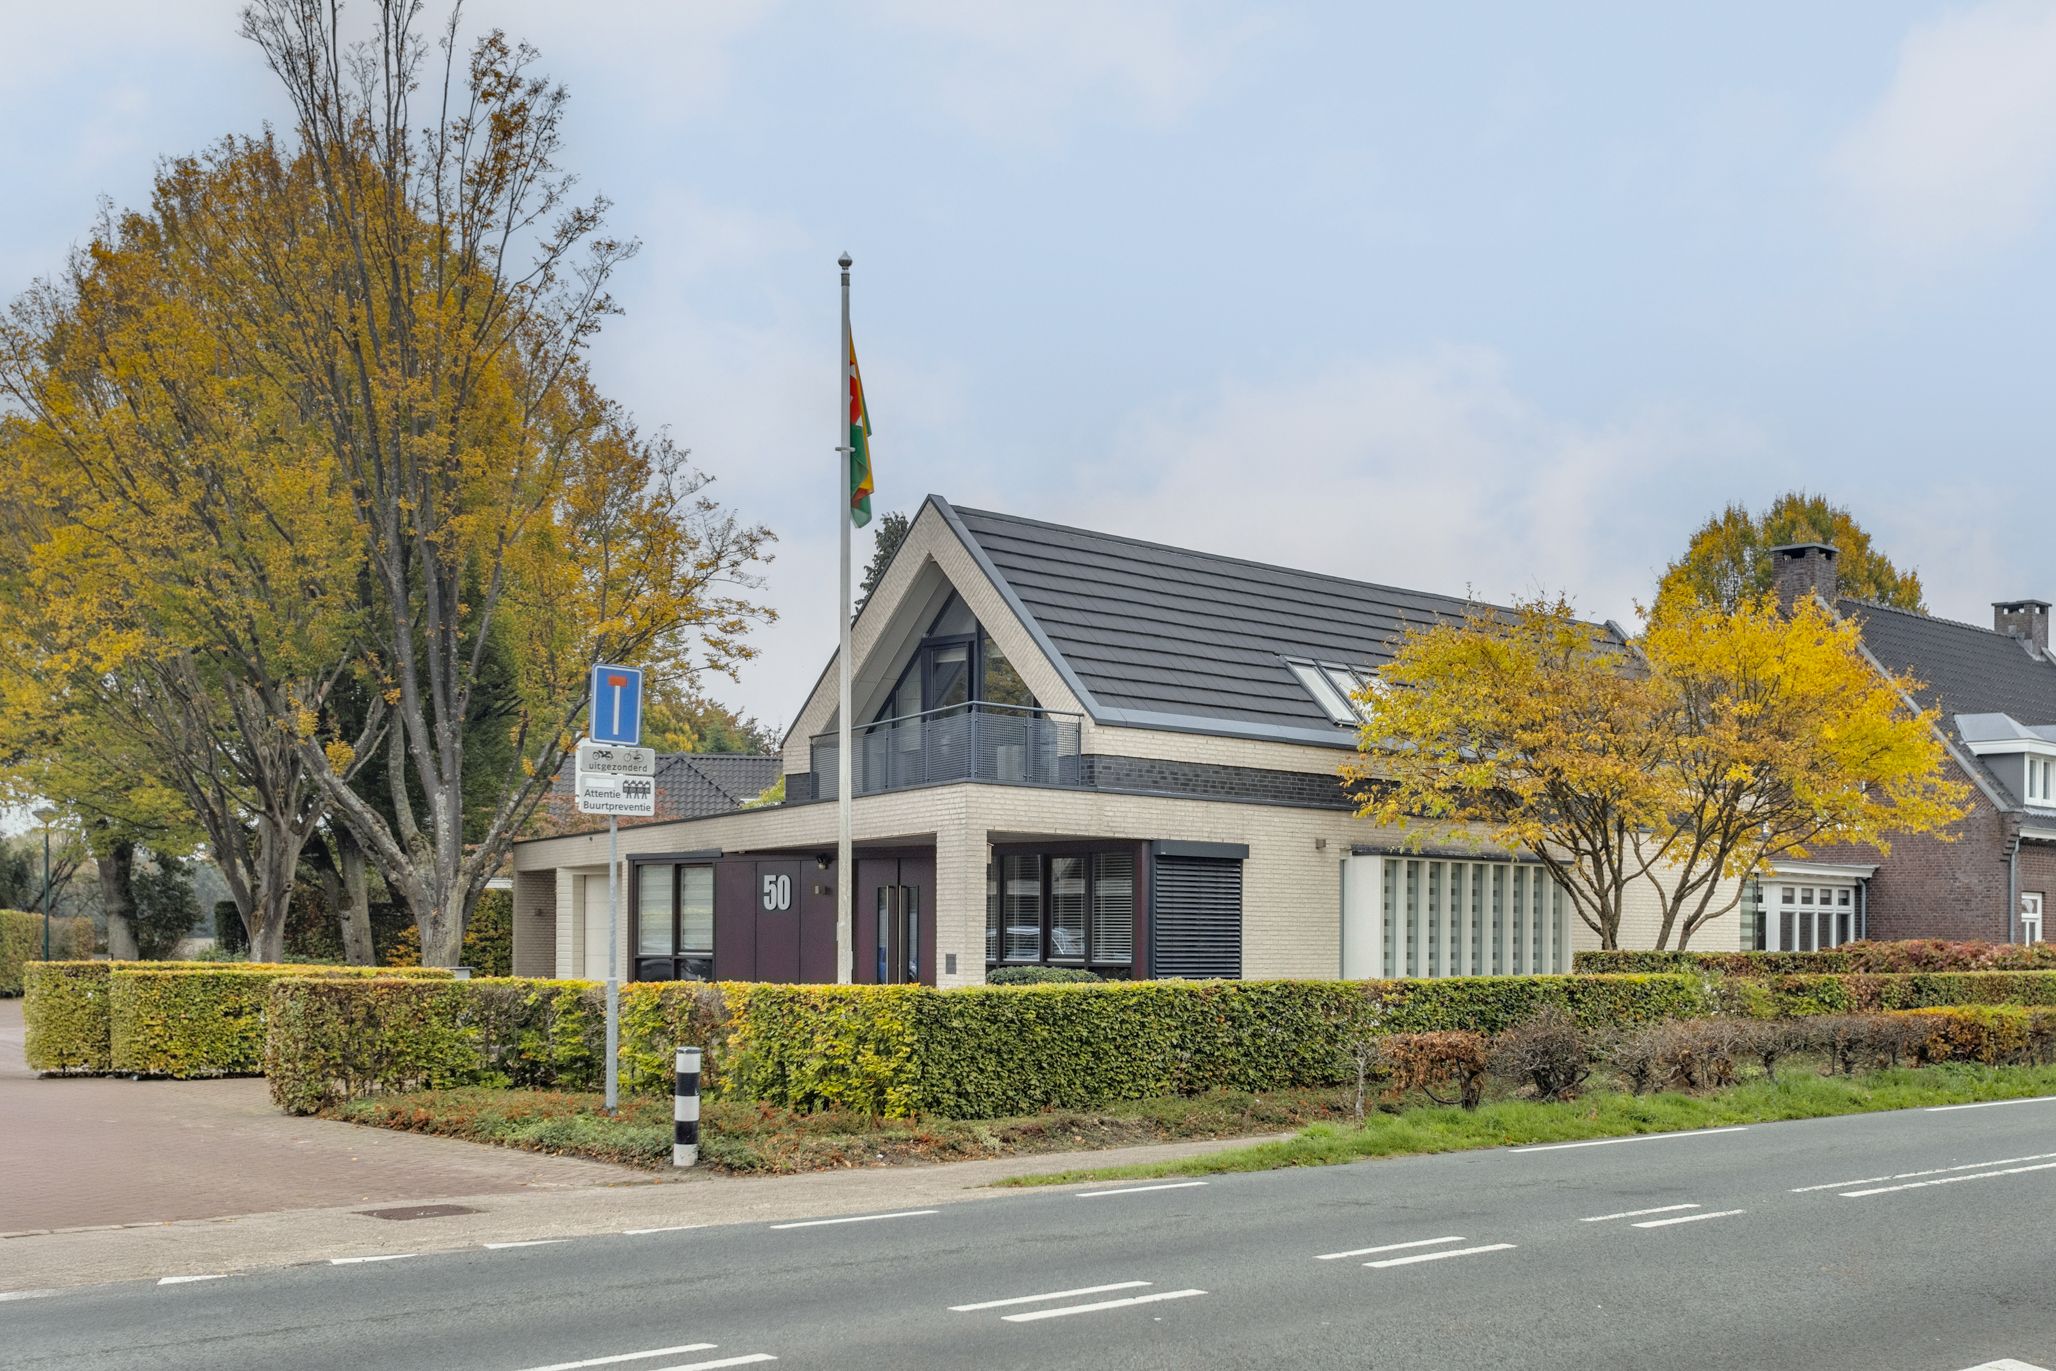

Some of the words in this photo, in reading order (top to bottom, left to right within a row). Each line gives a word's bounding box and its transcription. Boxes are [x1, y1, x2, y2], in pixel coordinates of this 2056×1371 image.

[589, 762, 648, 772] uitgezonderd
[584, 789, 621, 799] Attentie
[583, 801, 651, 812] Buurtpreventie
[763, 874, 791, 911] 50
